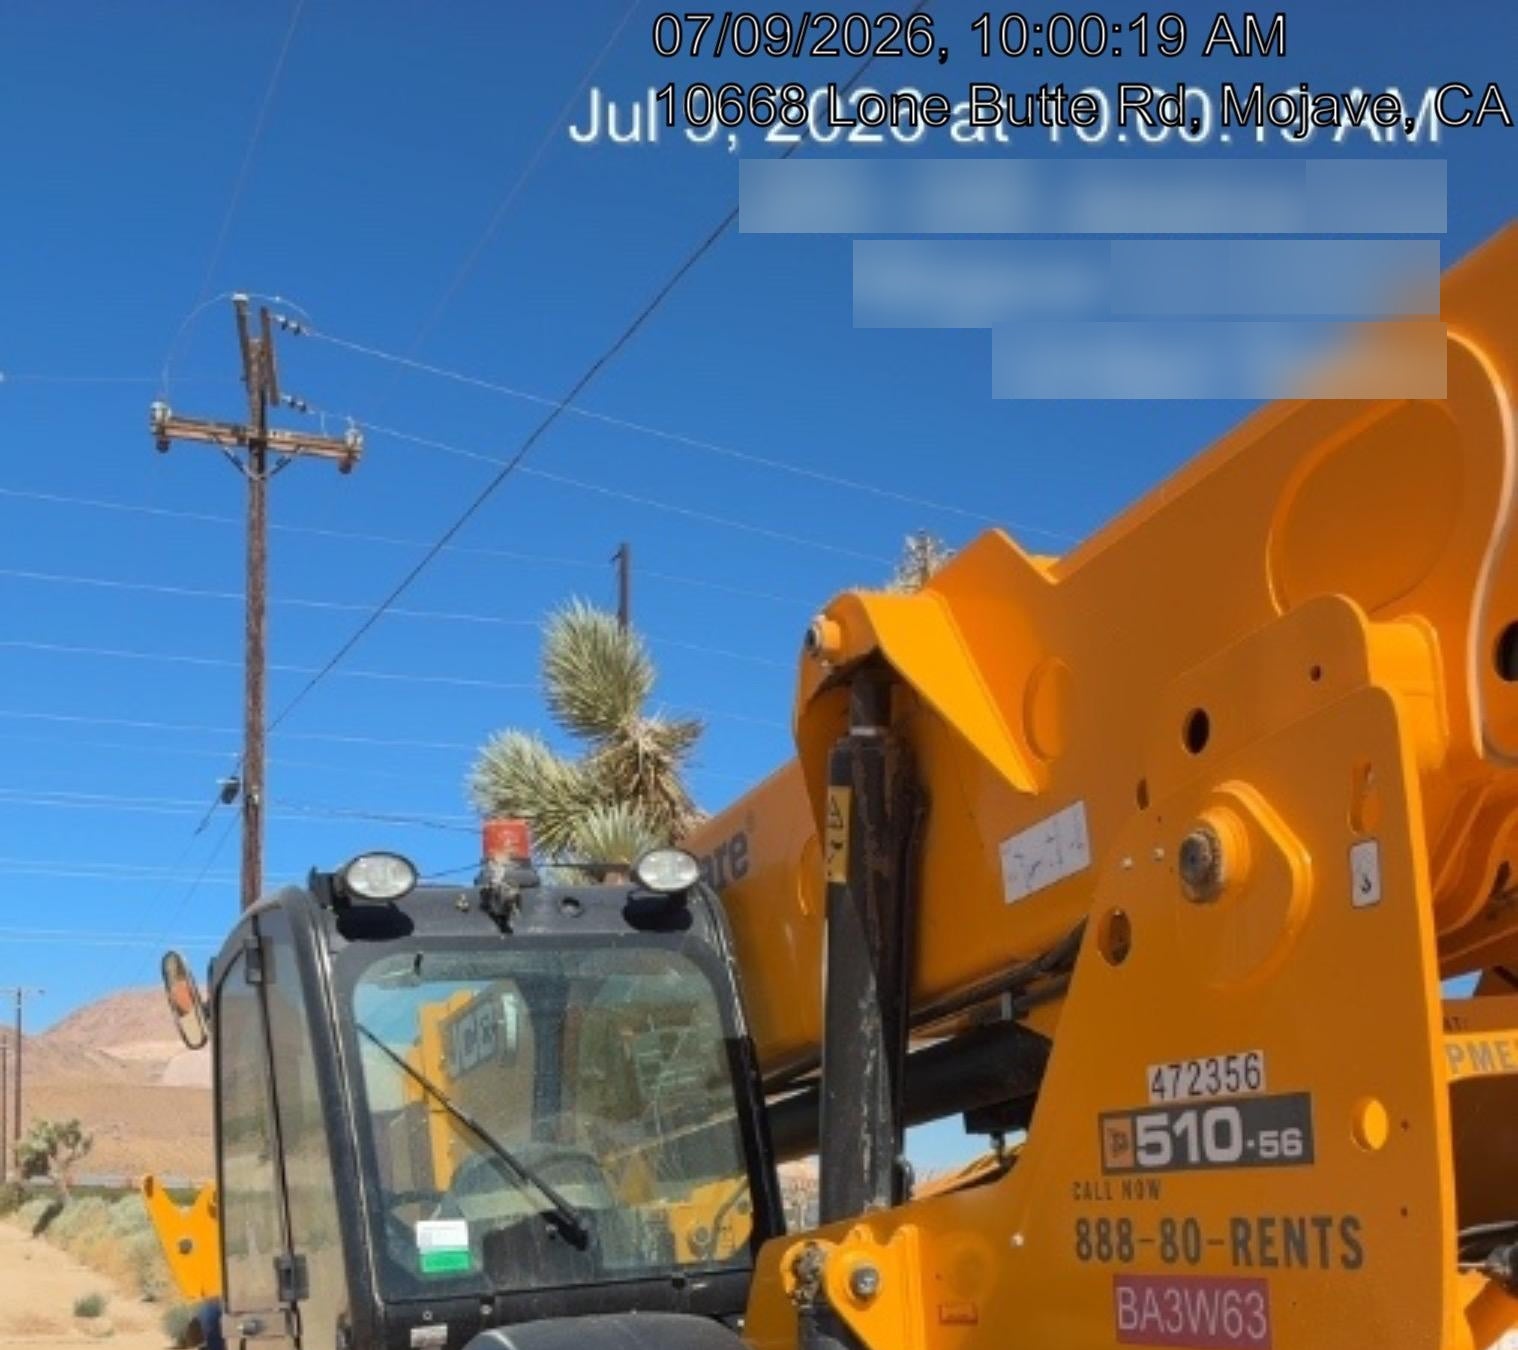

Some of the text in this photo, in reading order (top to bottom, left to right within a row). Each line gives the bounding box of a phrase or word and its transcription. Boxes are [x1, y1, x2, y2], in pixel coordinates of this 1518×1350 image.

[1151, 1052, 1262, 1099] 472356
[1072, 1178, 1161, 1200] CALL NOW
[1075, 1215, 1363, 1270] 888-80-RENTS
[1116, 1286, 1268, 1340] BA3W63
